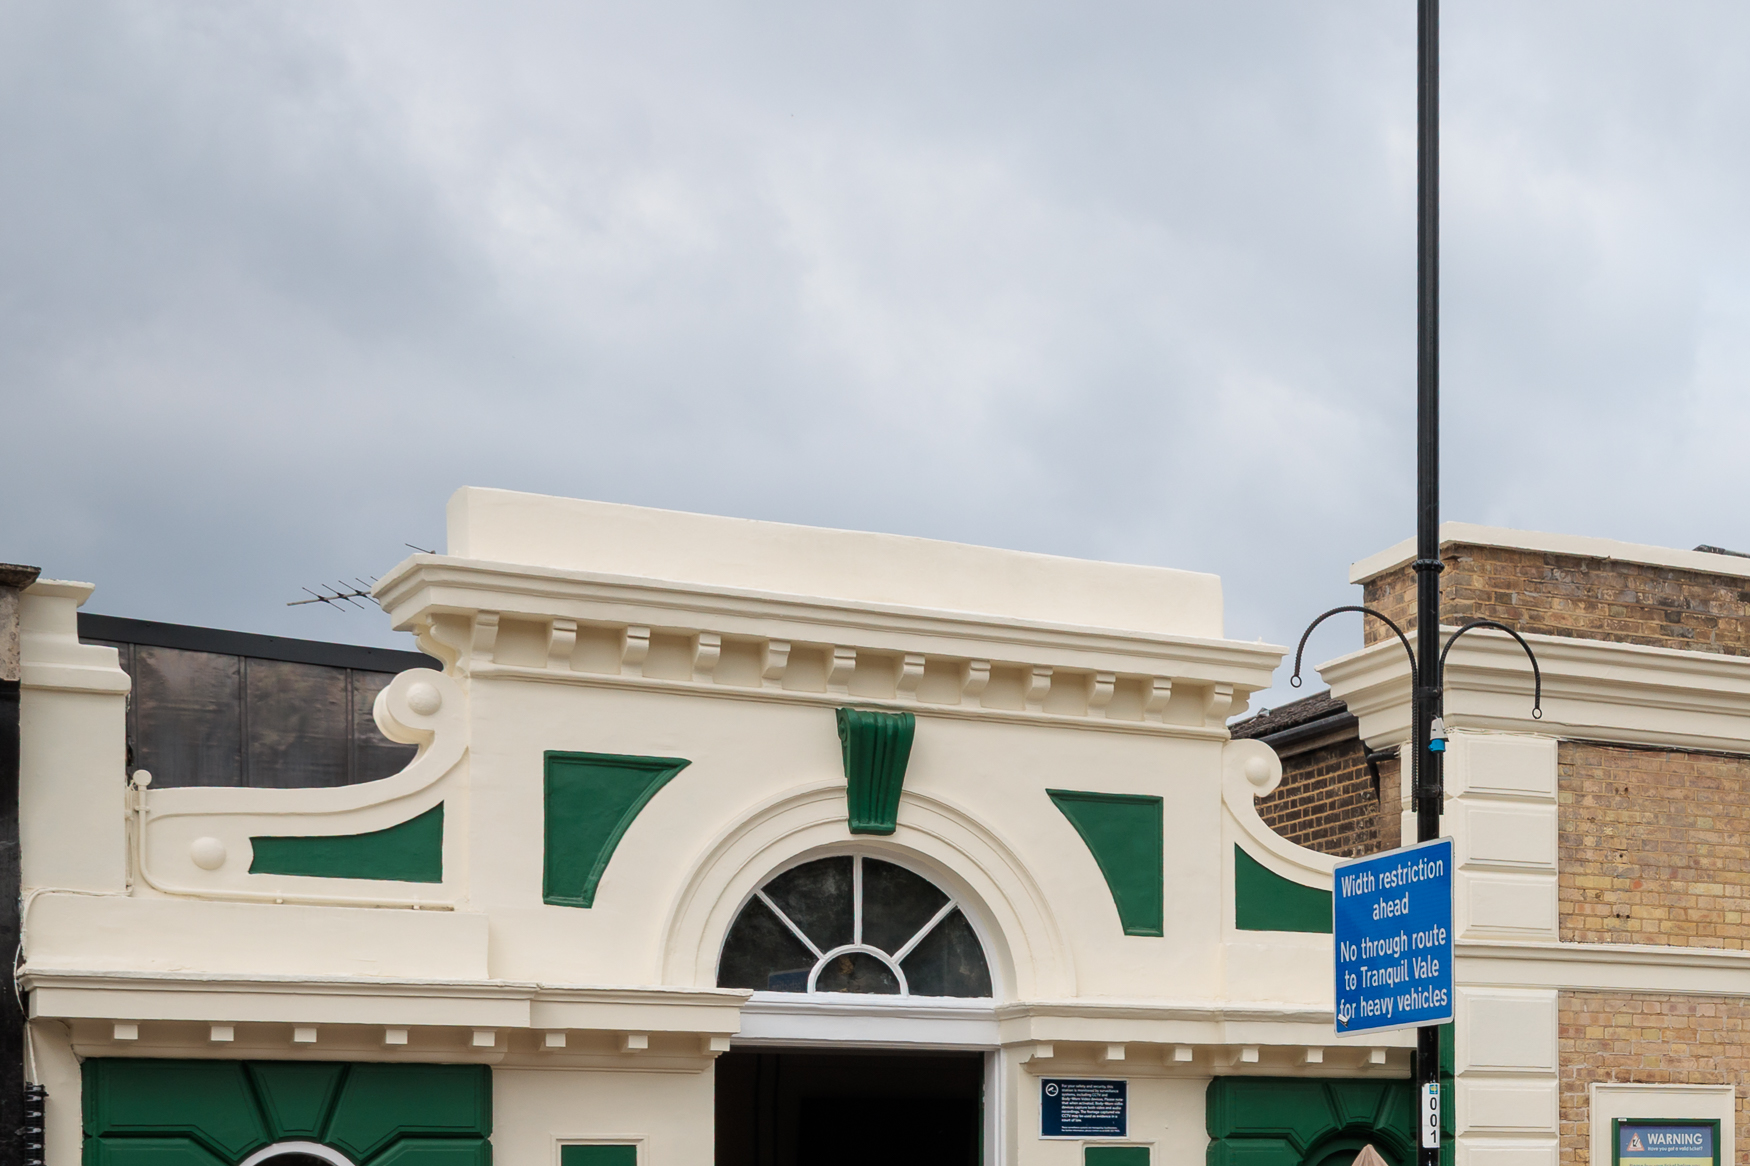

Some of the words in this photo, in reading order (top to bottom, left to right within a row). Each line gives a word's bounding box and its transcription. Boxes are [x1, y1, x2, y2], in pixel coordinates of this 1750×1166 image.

[1341, 871, 1374, 898] Width
[1379, 858, 1443, 889] restriction
[1373, 892, 1409, 920] ahead
[1340, 941, 1357, 963] No
[1361, 930, 1407, 959] through
[1412, 924, 1446, 949] route
[1345, 970, 1356, 990] to
[1361, 959, 1409, 988] Tranquil
[1413, 955, 1439, 979] Vale
[1340, 999, 1356, 1020] for
[1360, 996, 1393, 1018] heavy
[1397, 985, 1447, 1011] vehicles
[1648, 1133, 1703, 1144] WARNING
